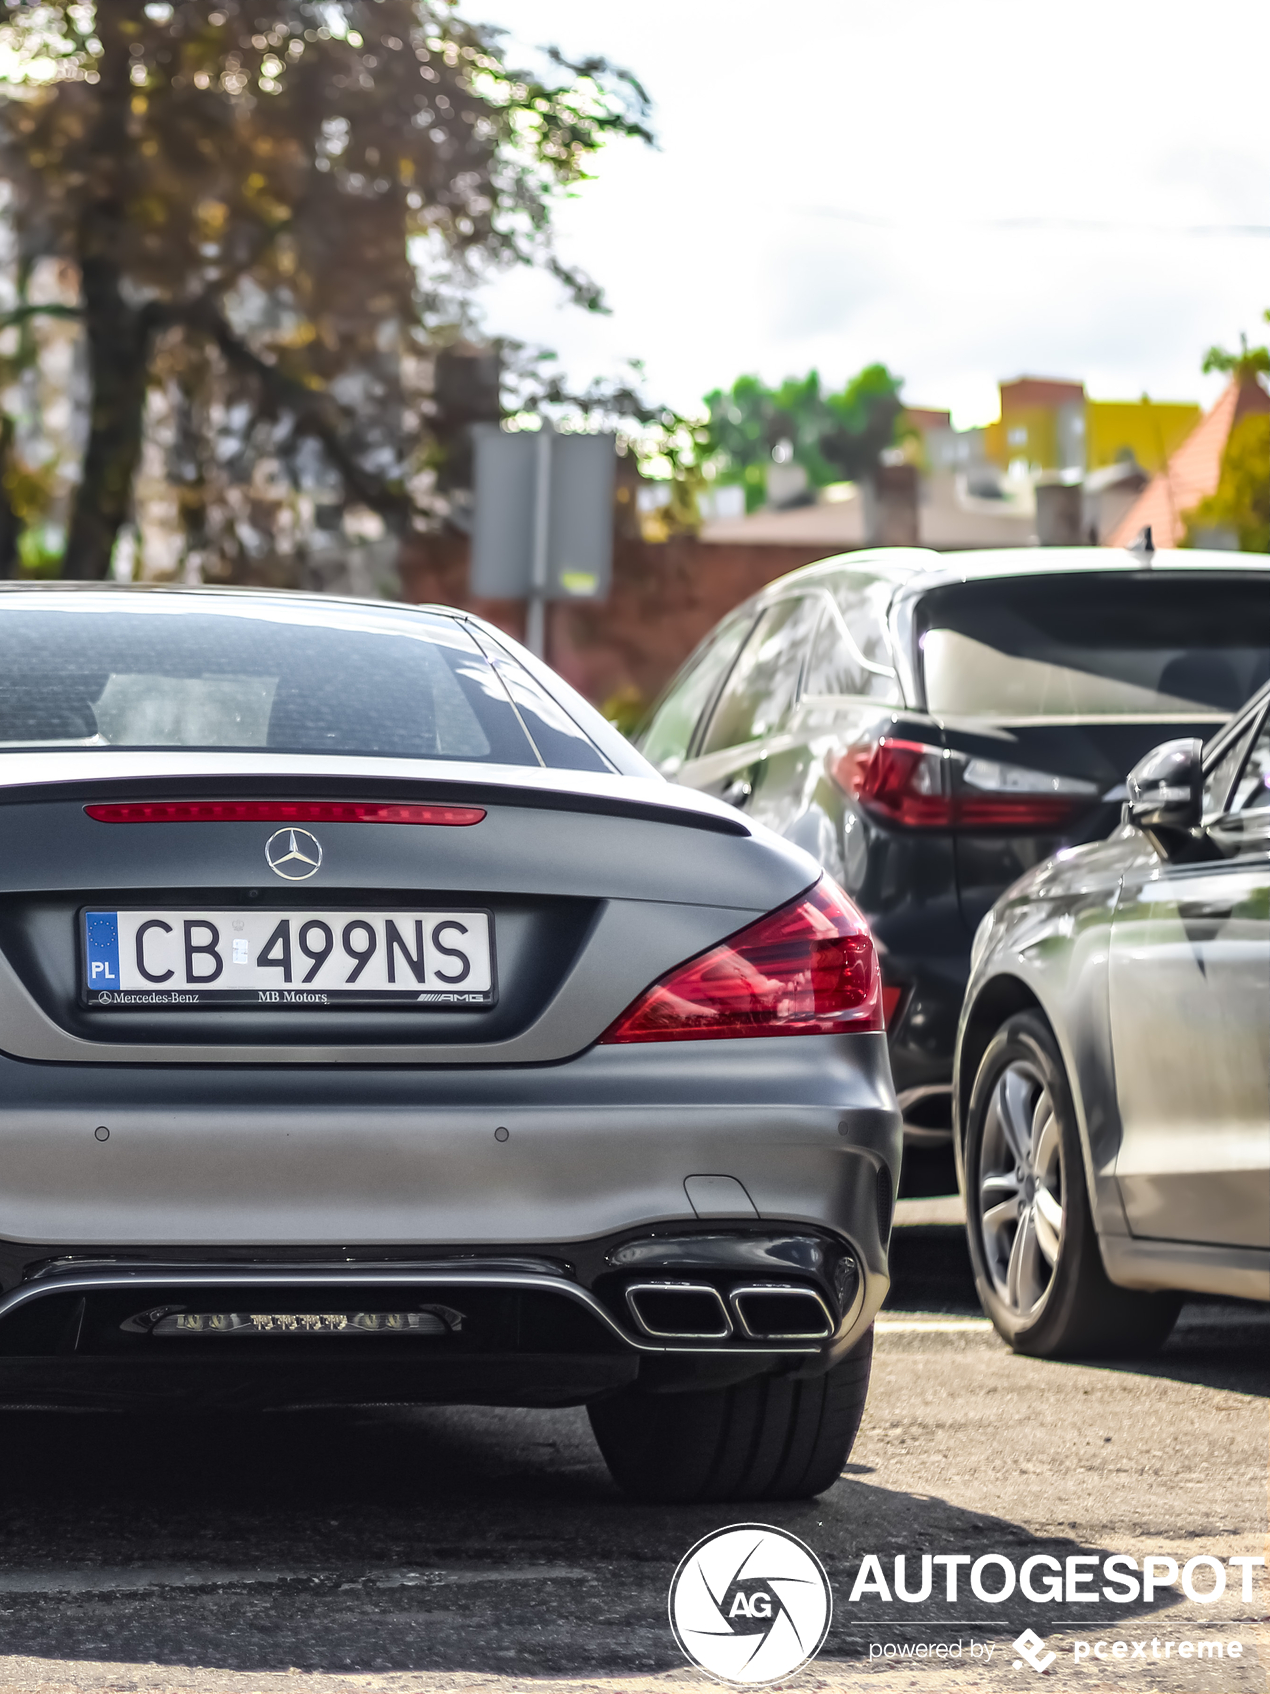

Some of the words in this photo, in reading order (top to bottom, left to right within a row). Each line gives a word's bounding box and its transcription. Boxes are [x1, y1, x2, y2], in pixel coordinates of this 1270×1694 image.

[135, 918, 224, 984] CB
[256, 918, 471, 984] 499NS
[91, 962, 115, 979] PL
[113, 992, 199, 1004] Mercedes-Benz
[257, 992, 280, 1003] MB
[283, 992, 328, 1003] Motors
[441, 993, 484, 1002] AMG
